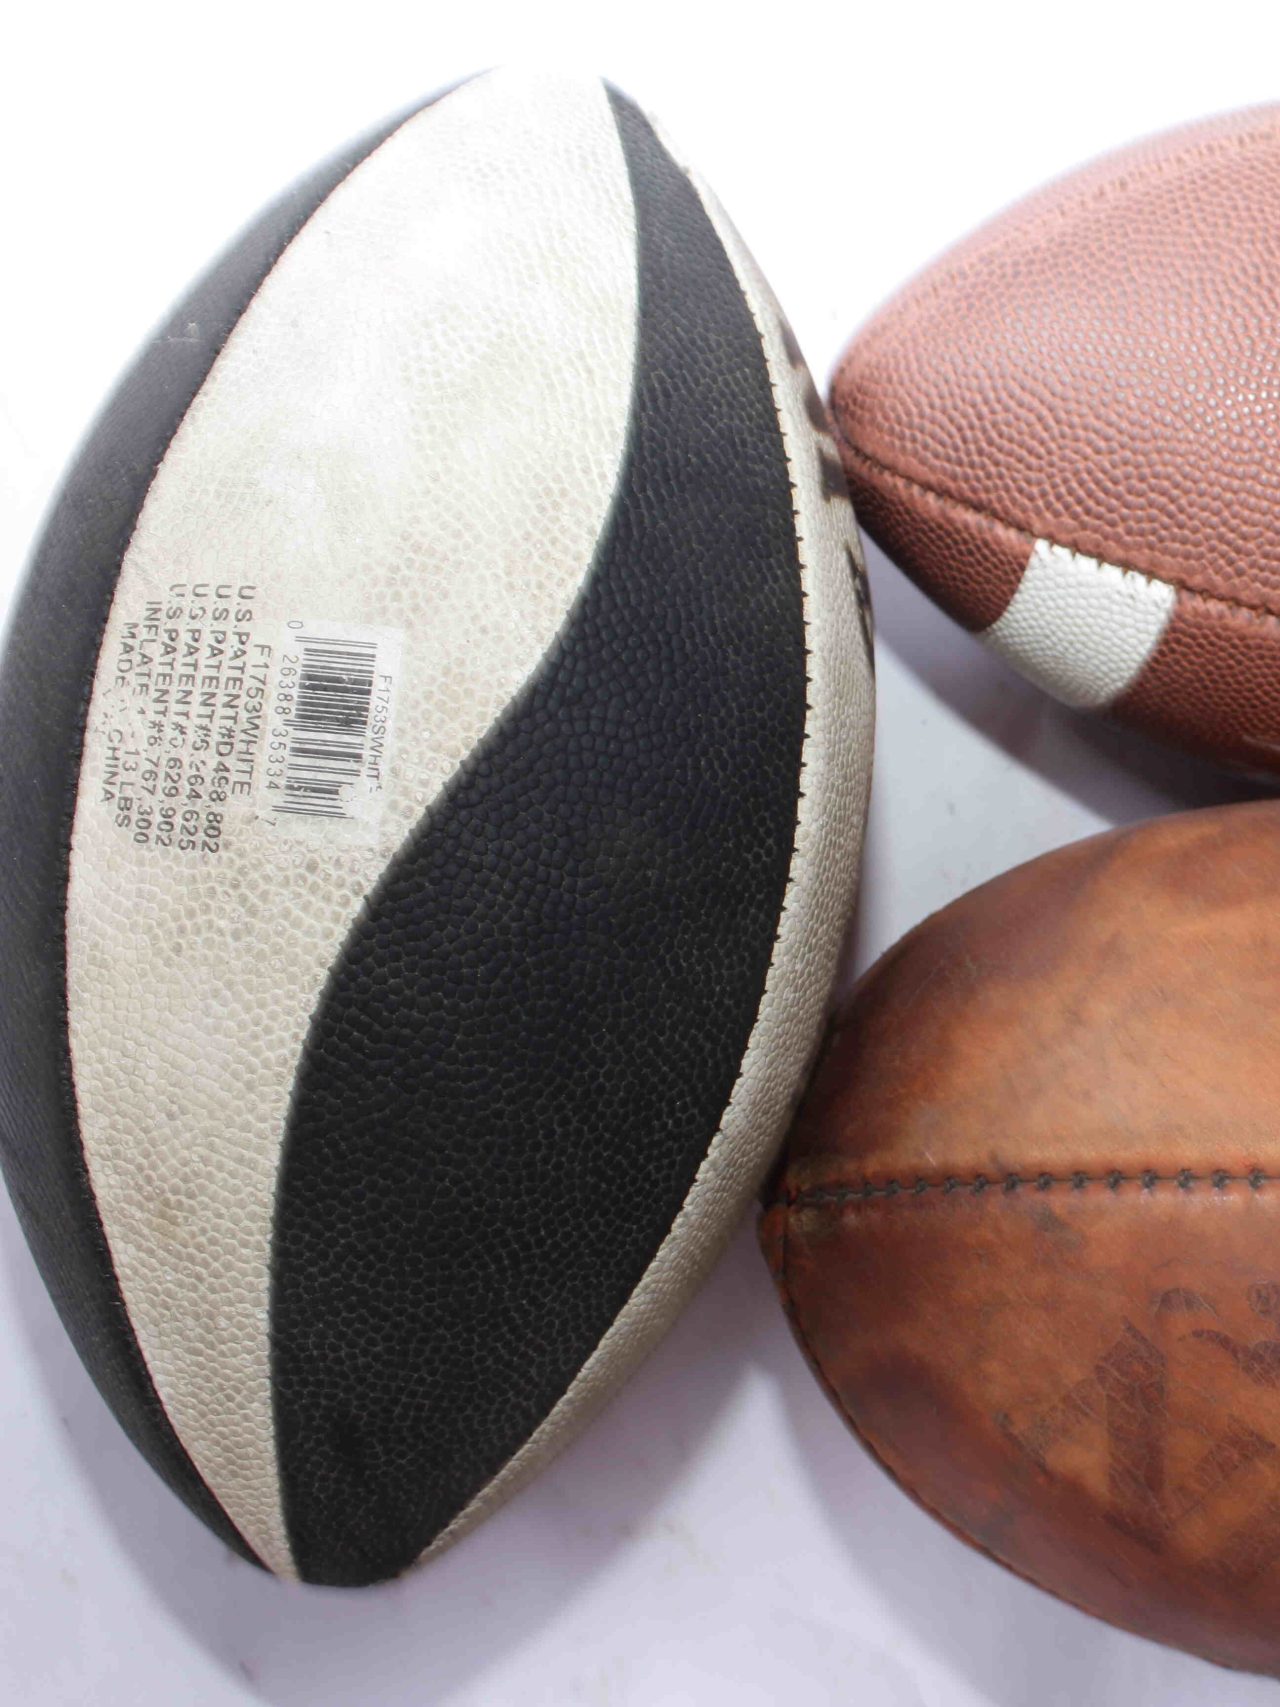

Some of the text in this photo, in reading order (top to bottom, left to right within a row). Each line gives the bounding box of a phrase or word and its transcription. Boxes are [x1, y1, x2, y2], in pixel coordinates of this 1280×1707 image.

[113, 621, 139, 689] MADE
[132, 600, 163, 697] INFLATE
[287, 619, 304, 630] 0
[273, 654, 300, 716] 26388
[231, 643, 272, 797] F1753WHITE
[99, 728, 124, 803] CHINA
[122, 747, 141, 772] 13
[264, 728, 290, 791] 35334
[115, 780, 136, 828] LBS
